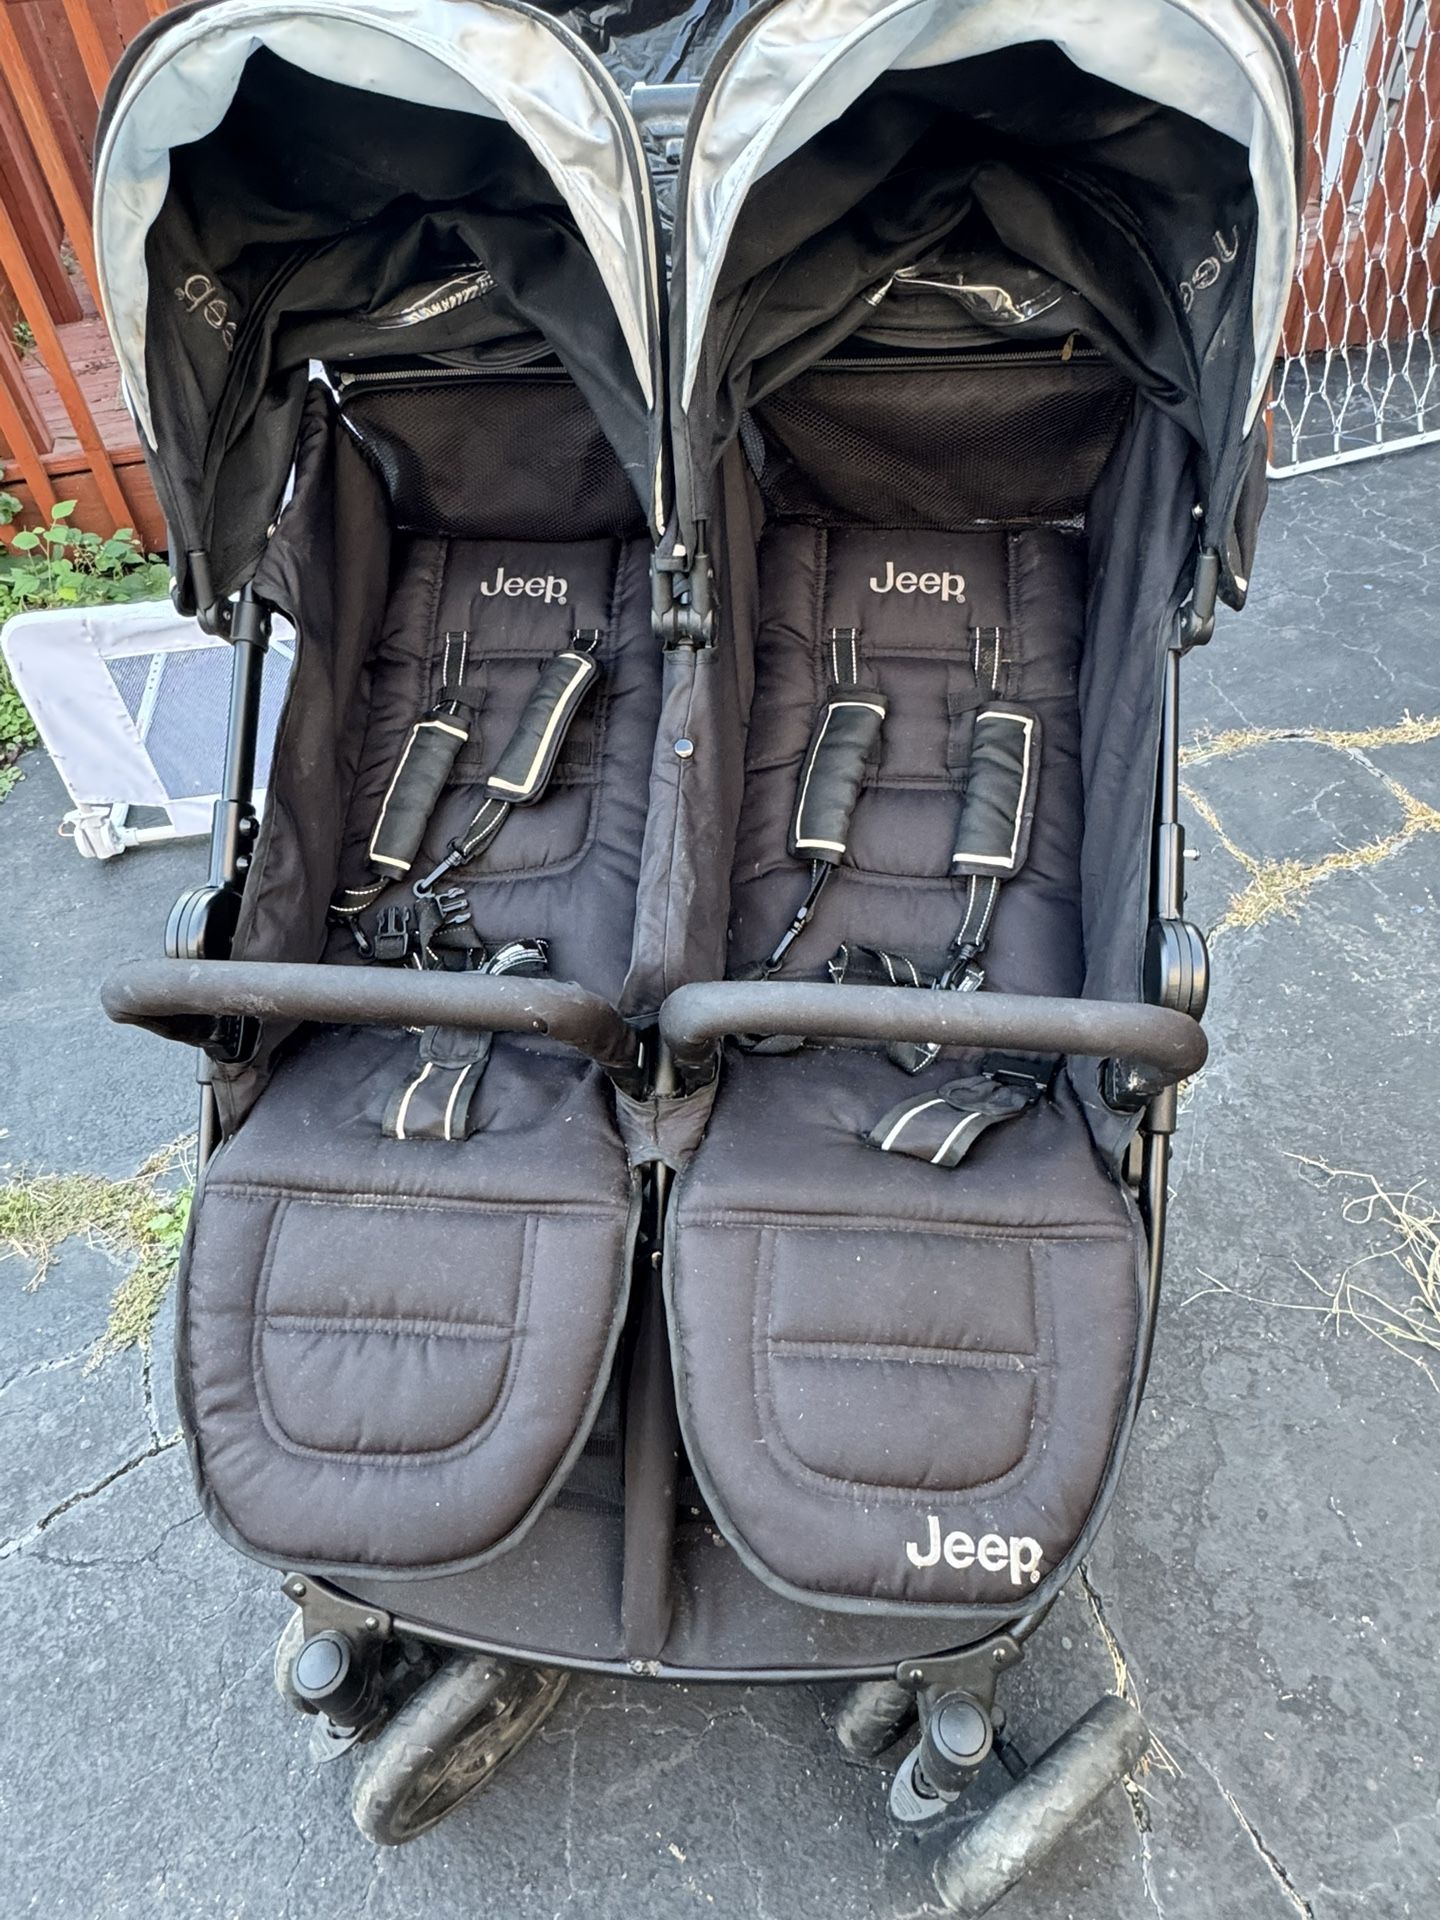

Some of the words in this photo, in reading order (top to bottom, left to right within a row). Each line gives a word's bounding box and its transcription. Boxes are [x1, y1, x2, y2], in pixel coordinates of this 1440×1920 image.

[480, 567, 568, 605] Jeep
[870, 561, 965, 603] Jeep
[906, 1515, 1043, 1584] Jeep
